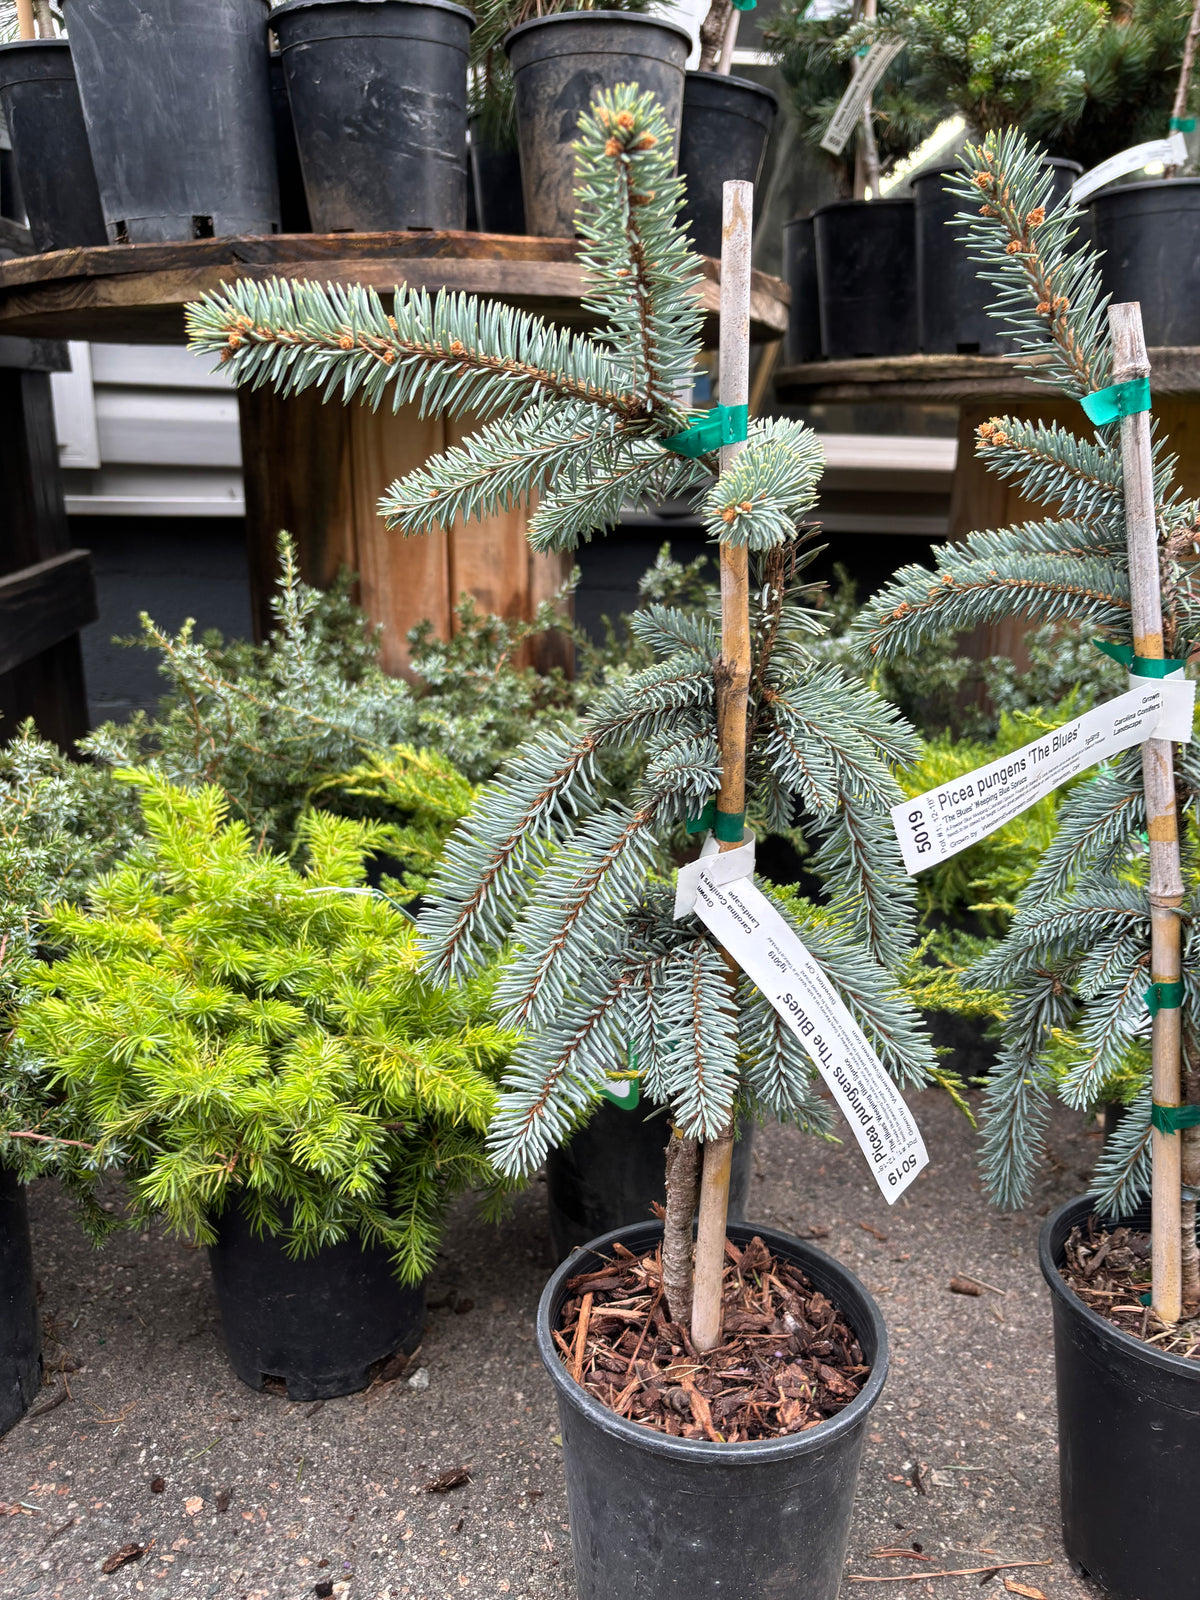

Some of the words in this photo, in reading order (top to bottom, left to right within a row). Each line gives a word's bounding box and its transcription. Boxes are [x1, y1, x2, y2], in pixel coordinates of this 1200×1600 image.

[938, 785, 974, 811] Picea
[977, 758, 1026, 797] pungens
[1028, 745, 1050, 764] 'The
[1052, 723, 1080, 753] Blues'
[974, 792, 998, 808] Weeping
[998, 786, 1010, 796] Blue
[908, 810, 931, 853] 5019
[939, 839, 948, 854] Pot
[697, 885, 714, 907] Grown
[703, 877, 727, 905] Conifers
[727, 905, 752, 934] Carolina
[728, 891, 760, 928] Landscape
[768, 951, 787, 973] 1g5019
[776, 993, 815, 1037] Blues'
[813, 1035, 832, 1069] 'The
[844, 1058, 859, 1081] Spruce
[833, 1066, 873, 1126] pungens
[857, 1080, 868, 1096] Blue
[866, 1094, 883, 1123] Weeping
[866, 1125, 887, 1163] Picea
[878, 1122, 892, 1140] Blues'
[888, 1154, 917, 1186] 5019
